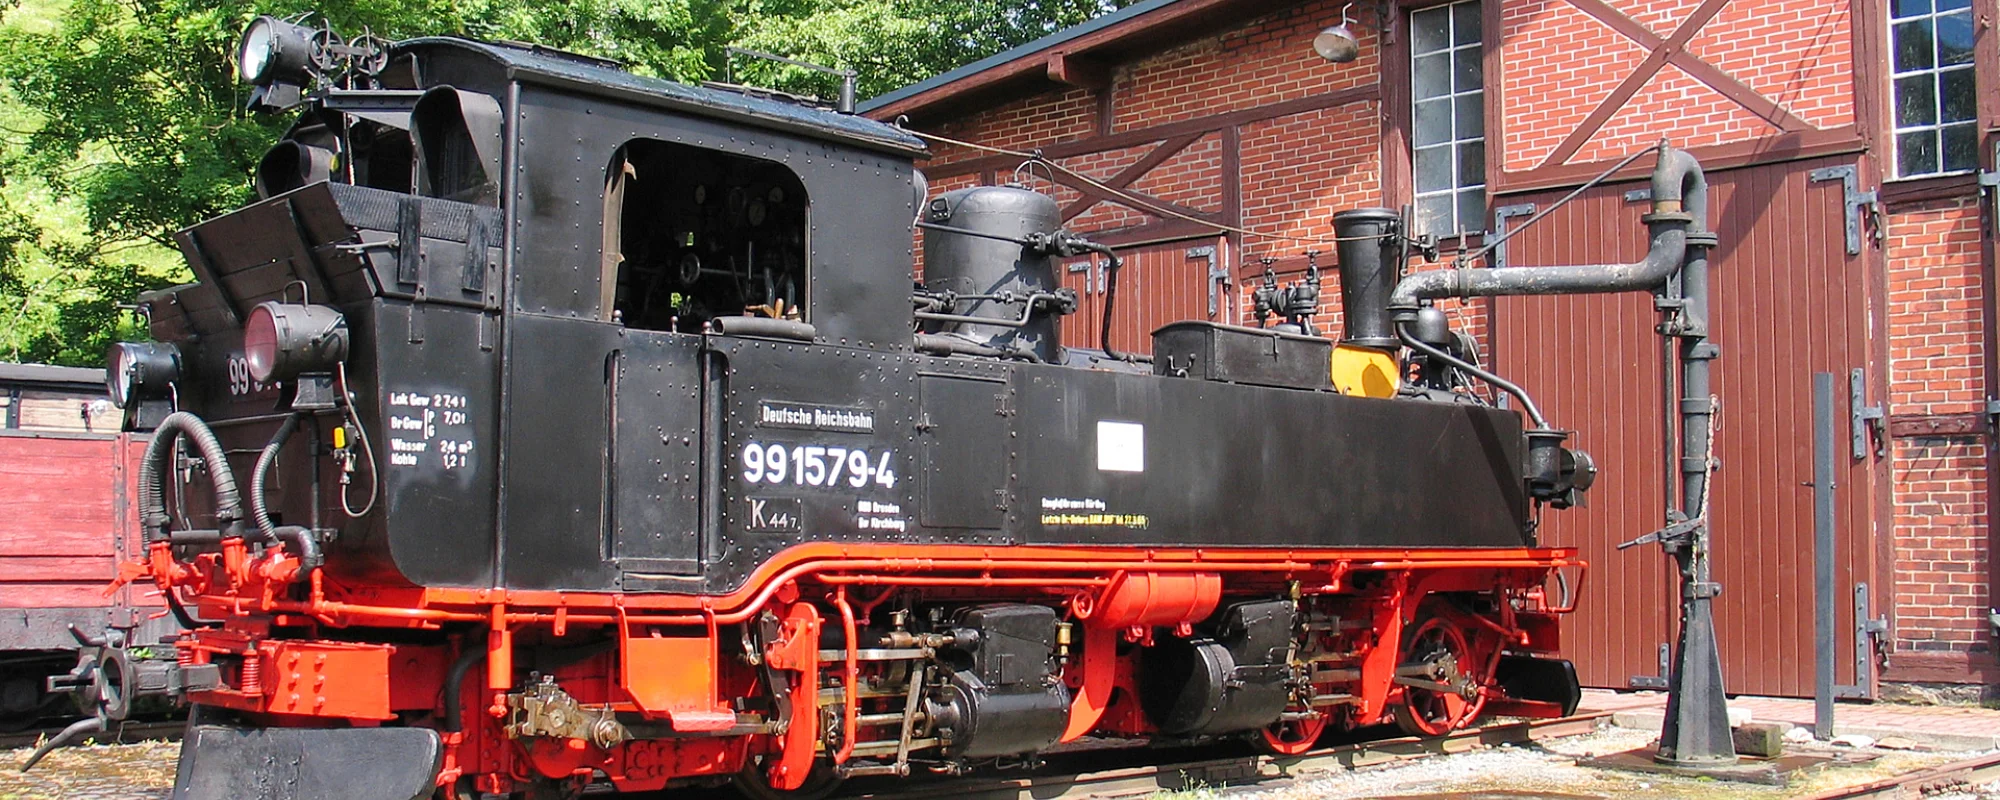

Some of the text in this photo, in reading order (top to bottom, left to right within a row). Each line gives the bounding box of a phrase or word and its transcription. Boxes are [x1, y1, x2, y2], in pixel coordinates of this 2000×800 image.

[229, 357, 249, 395] 99
[390, 392, 409, 405] Lok
[762, 405, 873, 429] Deutsche Reichsbahn
[391, 438, 426, 452] Wasser
[391, 453, 417, 465] Kohle
[751, 499, 767, 528] K
